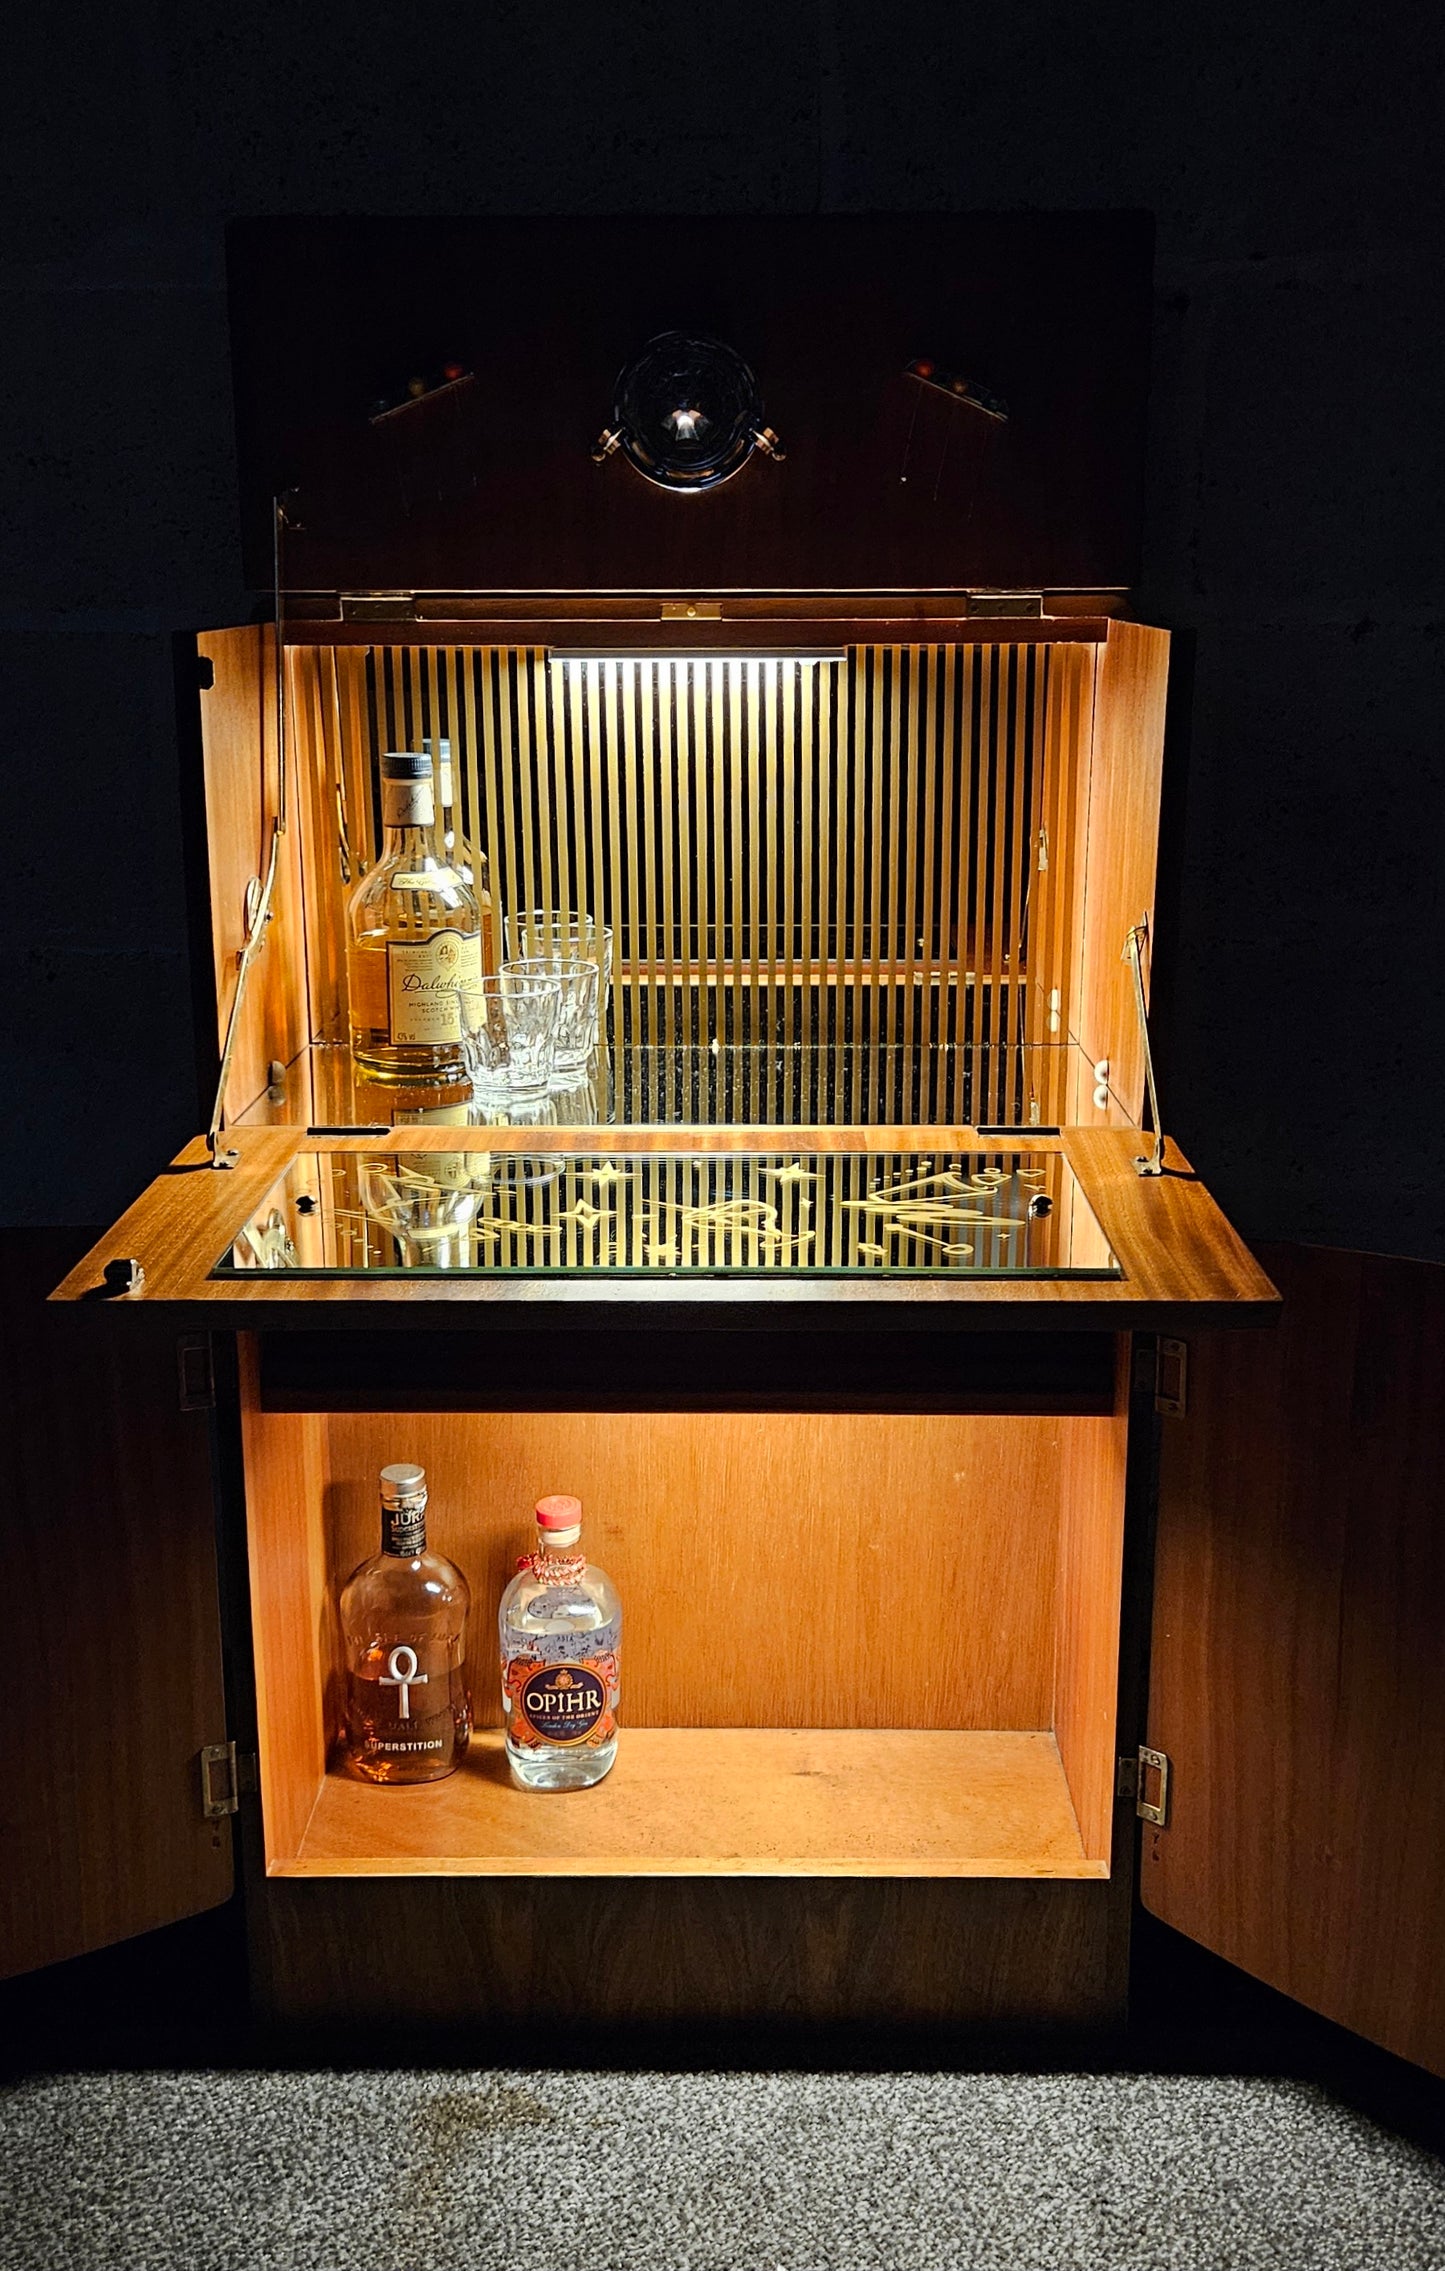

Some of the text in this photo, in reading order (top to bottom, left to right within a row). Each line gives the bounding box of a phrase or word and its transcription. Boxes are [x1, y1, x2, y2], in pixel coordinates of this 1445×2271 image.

[440, 1013, 455, 1026] 15
[526, 1689, 602, 1713] OPIHR
[364, 1739, 444, 1752] SUPERSTITION
